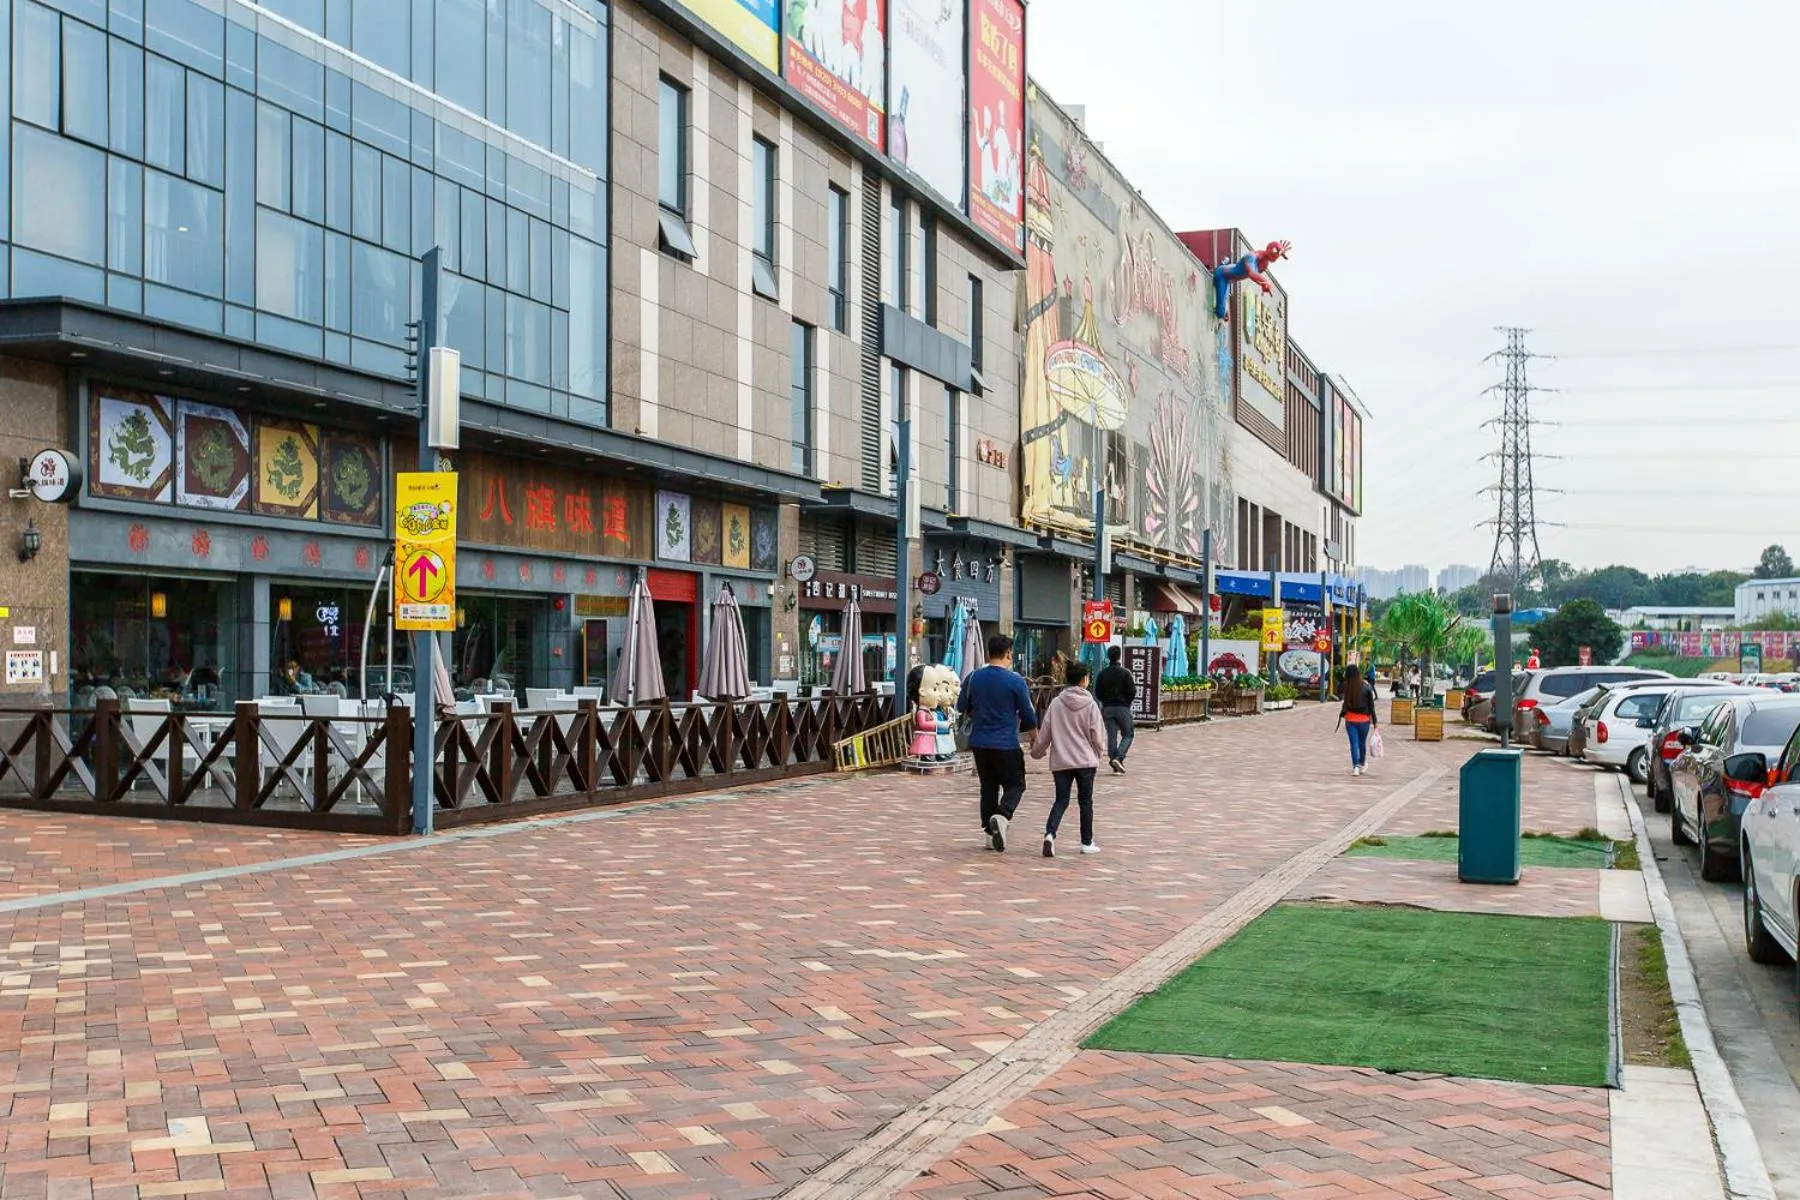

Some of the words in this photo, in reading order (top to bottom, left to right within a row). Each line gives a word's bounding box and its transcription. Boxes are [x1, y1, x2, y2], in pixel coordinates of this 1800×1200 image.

[480, 479, 629, 542] 八旗味道
[936, 549, 995, 584] 大食四方
